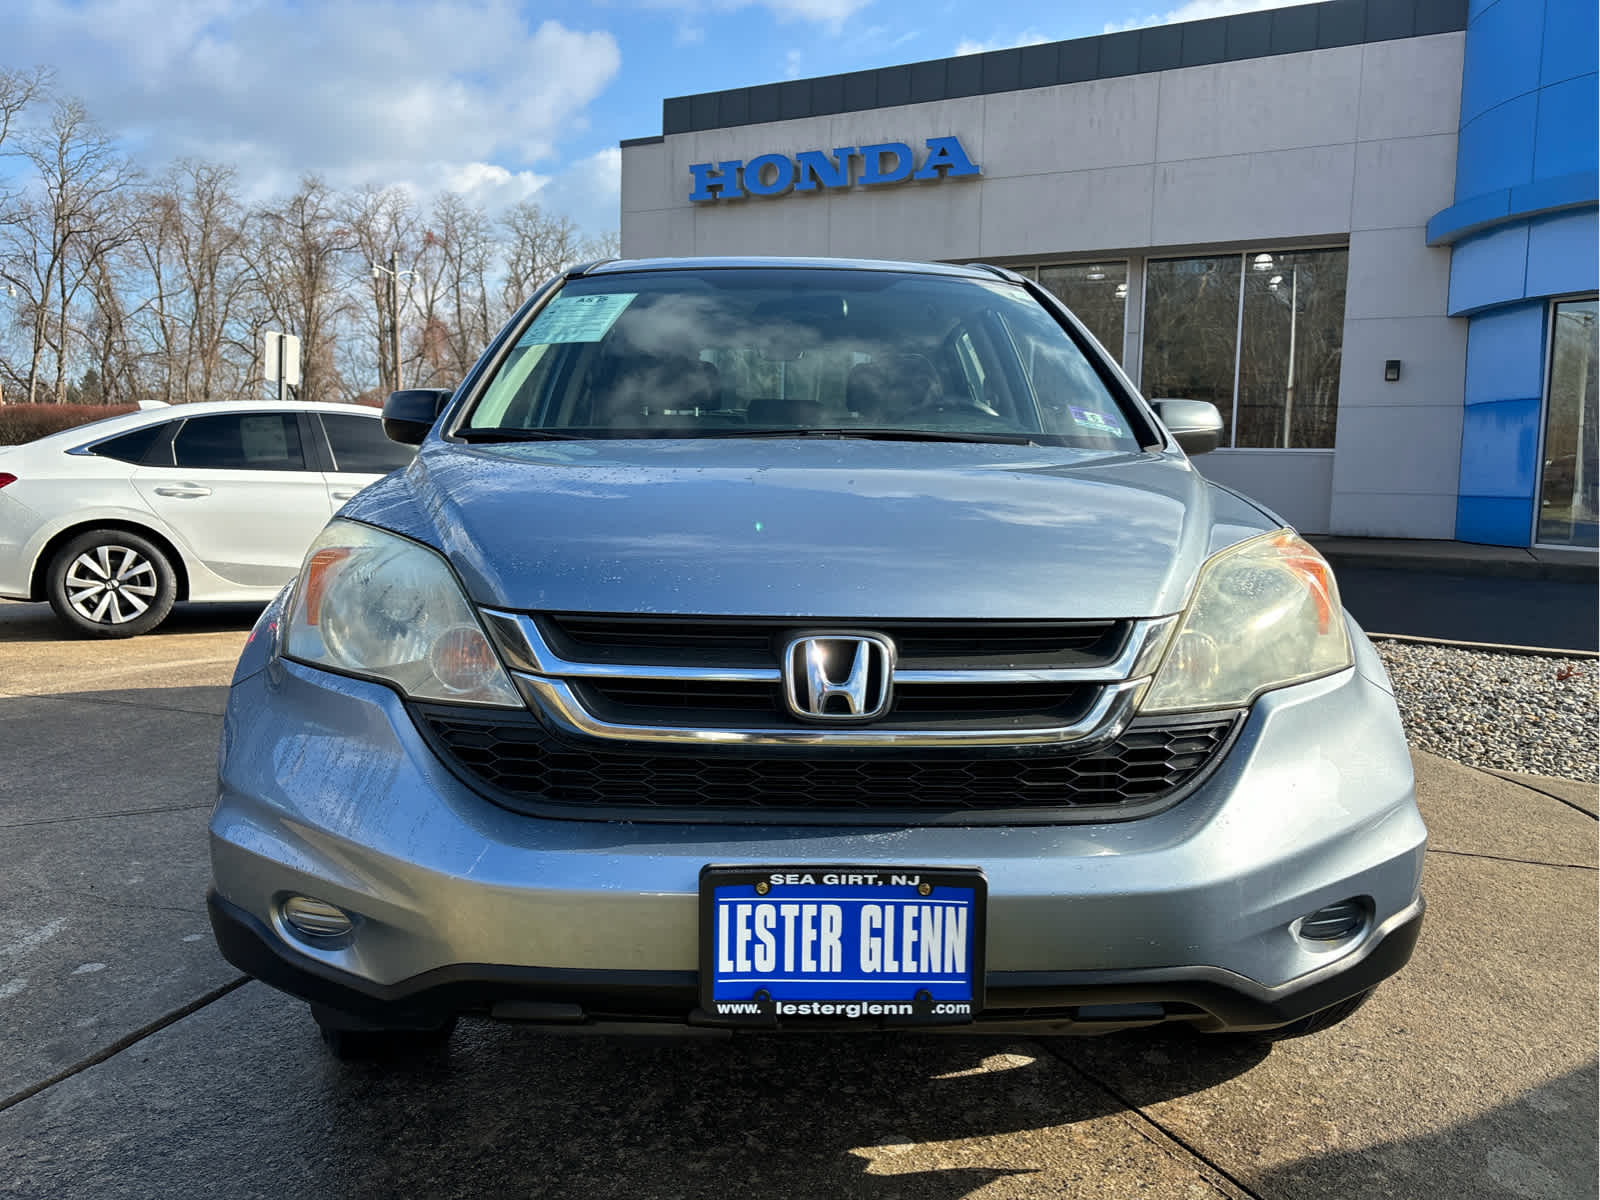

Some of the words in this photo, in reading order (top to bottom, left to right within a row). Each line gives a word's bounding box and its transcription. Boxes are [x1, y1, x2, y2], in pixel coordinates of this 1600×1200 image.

[688, 136, 981, 202] HONDA
[769, 873, 816, 886] SEA
[822, 874, 884, 887] GIRT,
[891, 874, 921, 887] NJ
[718, 904, 843, 973] LESTER
[860, 904, 968, 974] GLENN
[717, 1003, 761, 1015] www.
[775, 1001, 913, 1017] lesterglenn
[930, 1003, 971, 1015] .com
